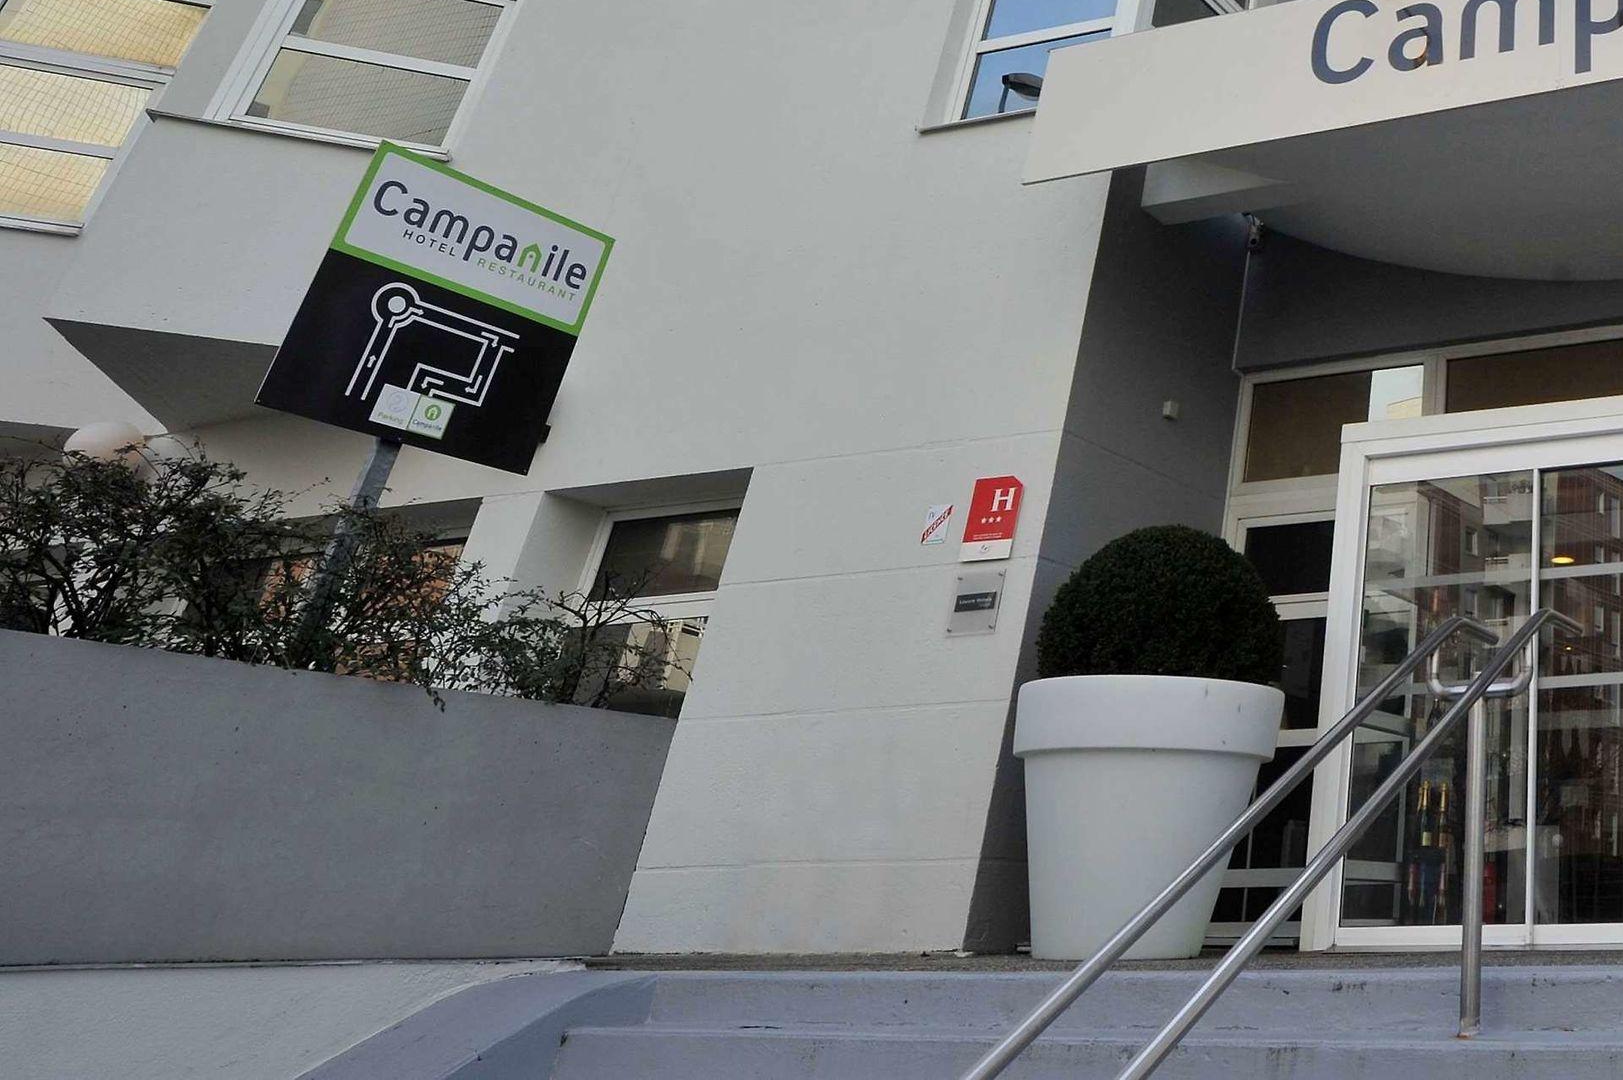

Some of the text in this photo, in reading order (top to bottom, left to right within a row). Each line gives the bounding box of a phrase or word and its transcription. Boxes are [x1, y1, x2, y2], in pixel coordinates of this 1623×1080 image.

[374, 180, 588, 291] Campanile
[402, 230, 577, 302] HOTEL RESTAURANT
[991, 487, 1017, 512] H
